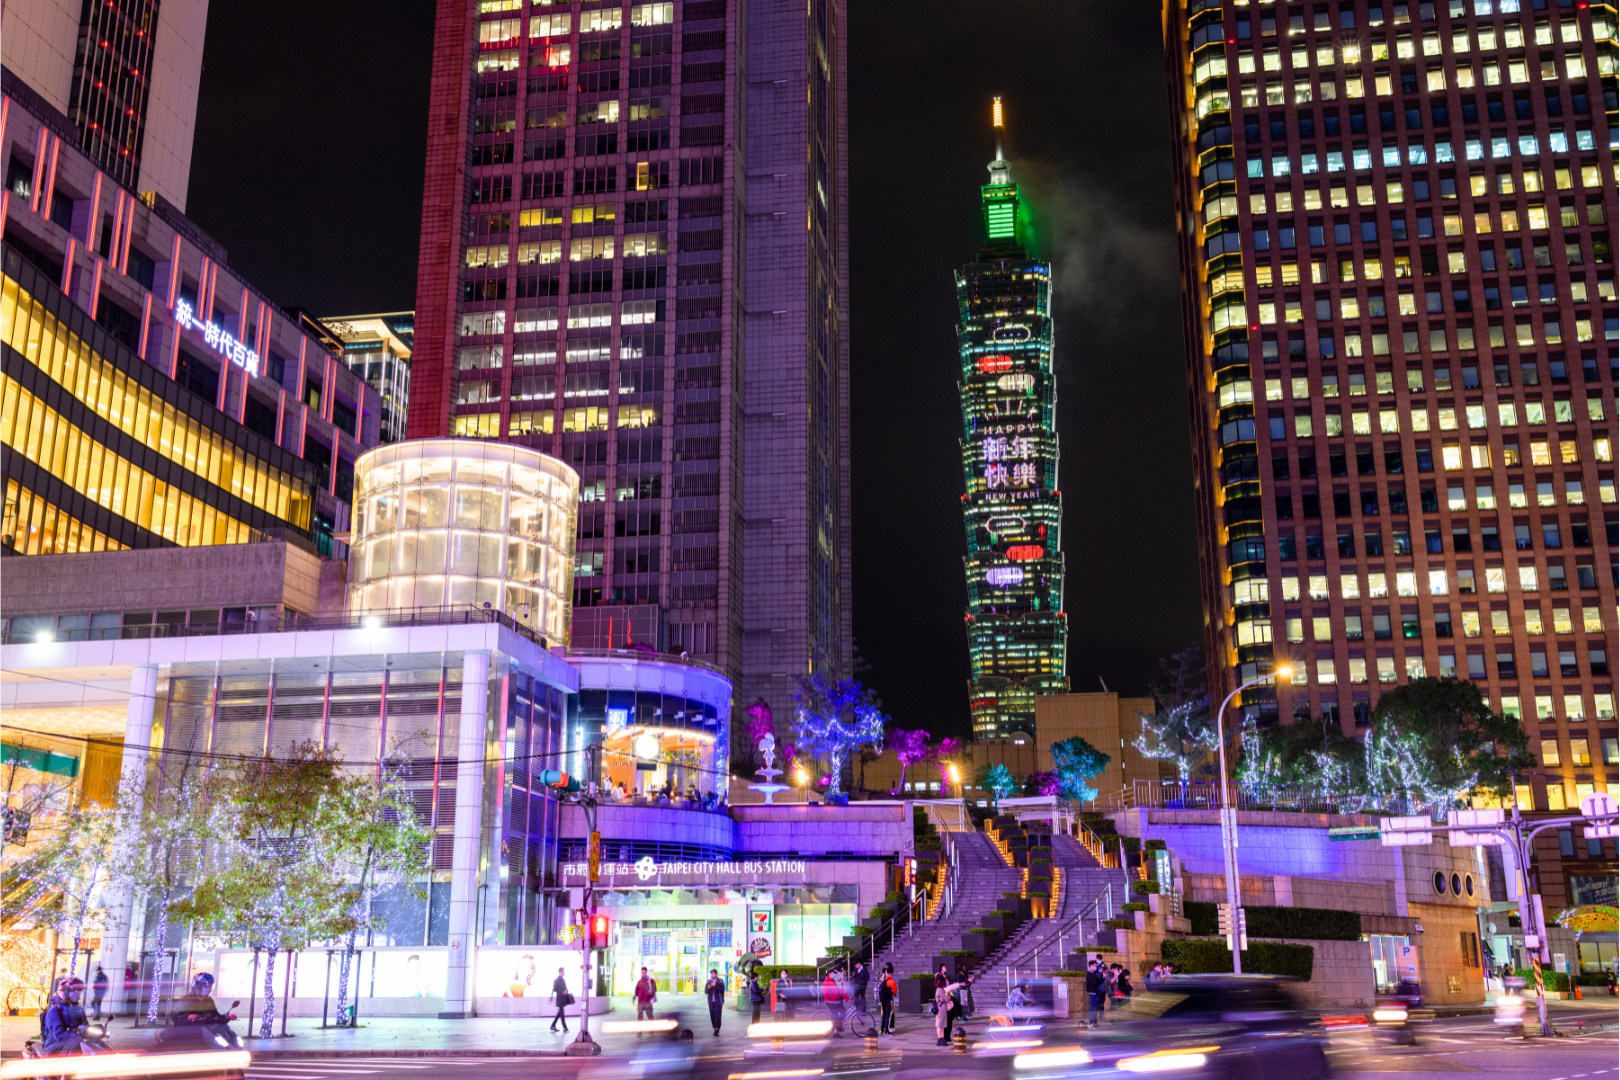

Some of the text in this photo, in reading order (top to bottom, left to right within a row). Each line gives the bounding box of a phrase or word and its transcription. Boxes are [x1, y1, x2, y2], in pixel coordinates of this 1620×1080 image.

[175, 298, 259, 378] 統一時代百貨
[984, 424, 1034, 434] HAPPY
[985, 492, 1006, 500] NEW
[563, 863, 629, 876] 市府運站
[663, 860, 805, 874] TAIPEI CITY HALL BUS STATION
[1403, 947, 1410, 956] P
